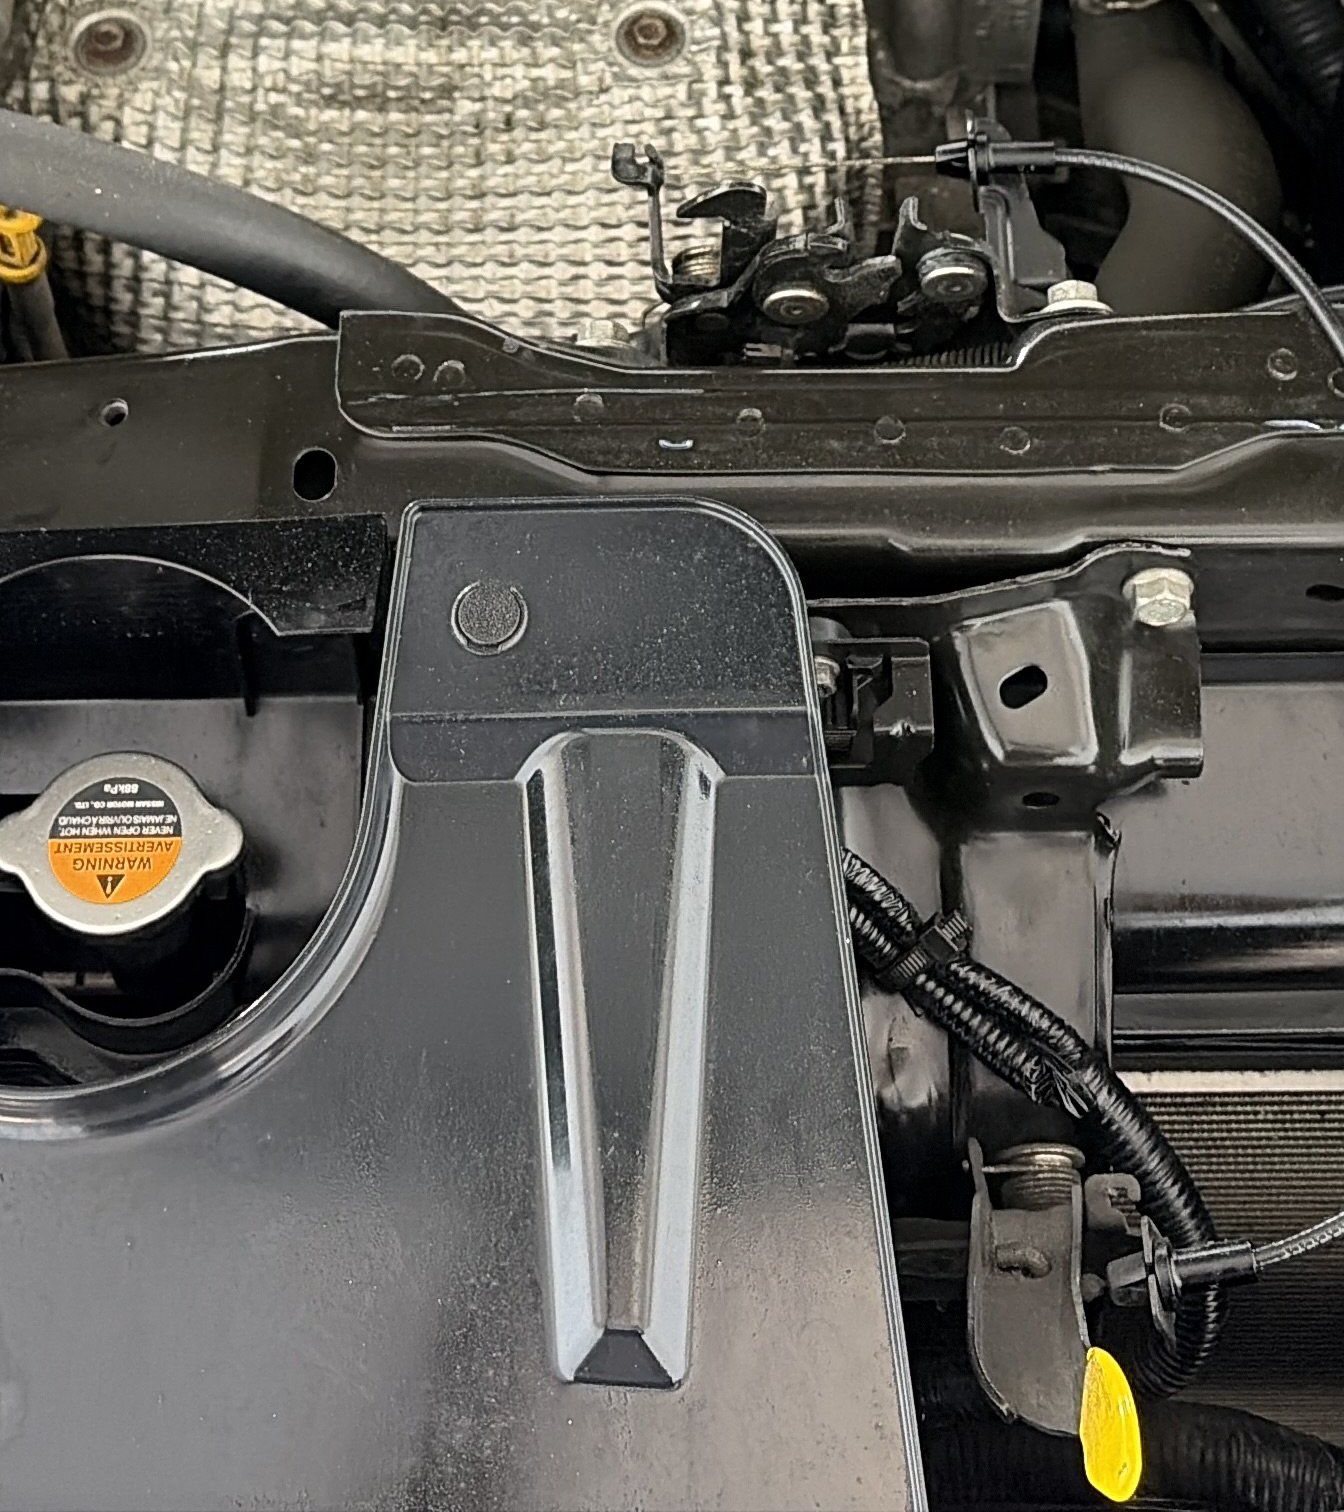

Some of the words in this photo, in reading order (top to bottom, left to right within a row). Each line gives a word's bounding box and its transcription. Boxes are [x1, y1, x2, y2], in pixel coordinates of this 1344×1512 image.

[98, 816, 132, 825] OUVRIR
[132, 815, 165, 824] JAMAIS
[82, 826, 113, 836] WHEN
[113, 826, 141, 835] OPEN
[142, 825, 174, 835] NEVER
[54, 841, 174, 855] AVERTISSEMENT
[73, 857, 152, 872] WARNING
